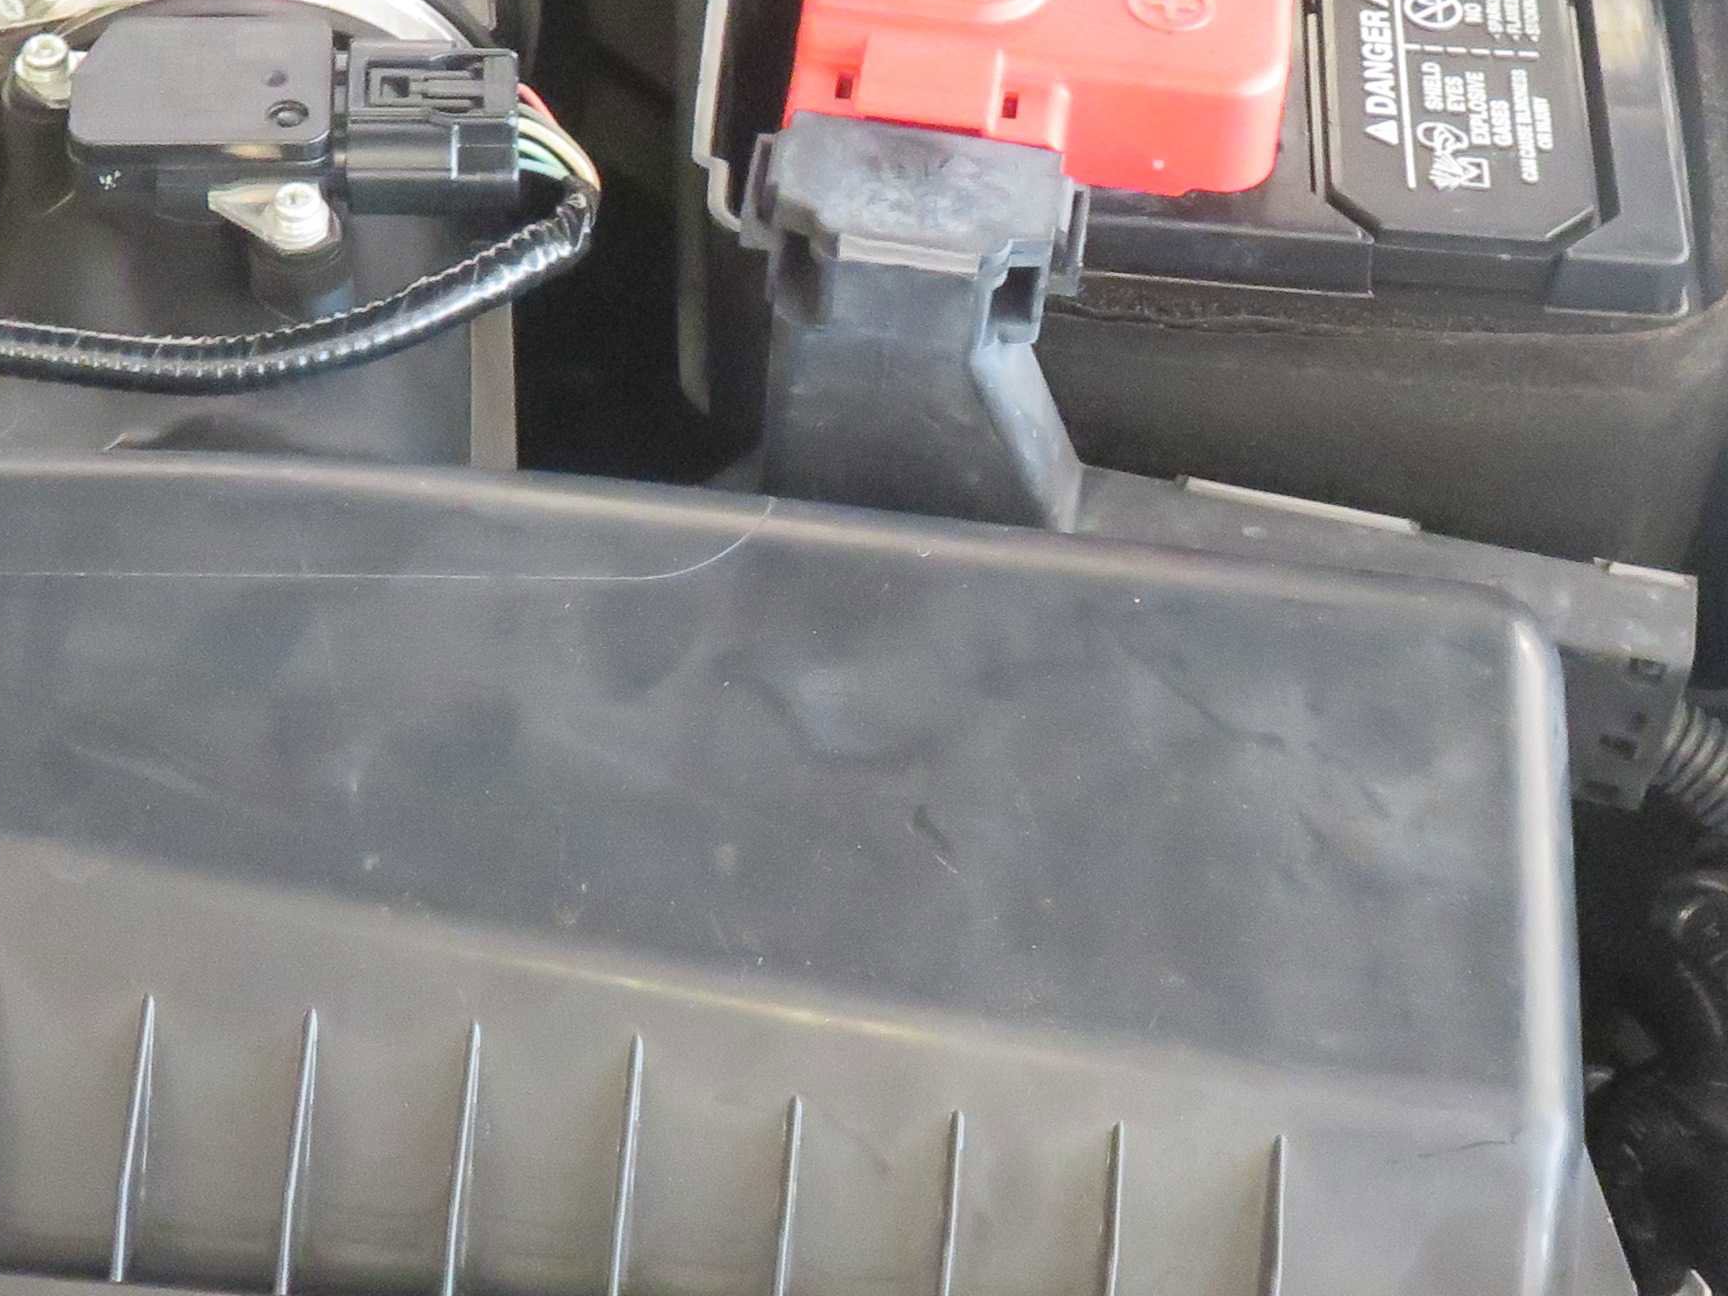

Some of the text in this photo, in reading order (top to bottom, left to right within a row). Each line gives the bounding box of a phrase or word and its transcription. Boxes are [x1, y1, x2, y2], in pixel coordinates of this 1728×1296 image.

[1464, 2, 1484, 24] NO
[1358, 9, 1398, 116] DANGER
[1421, 61, 1444, 112] SHIELD
[1444, 75, 1466, 112] EYES
[1465, 71, 1492, 146] EXPLOSIVE
[1489, 99, 1513, 147] GASES
